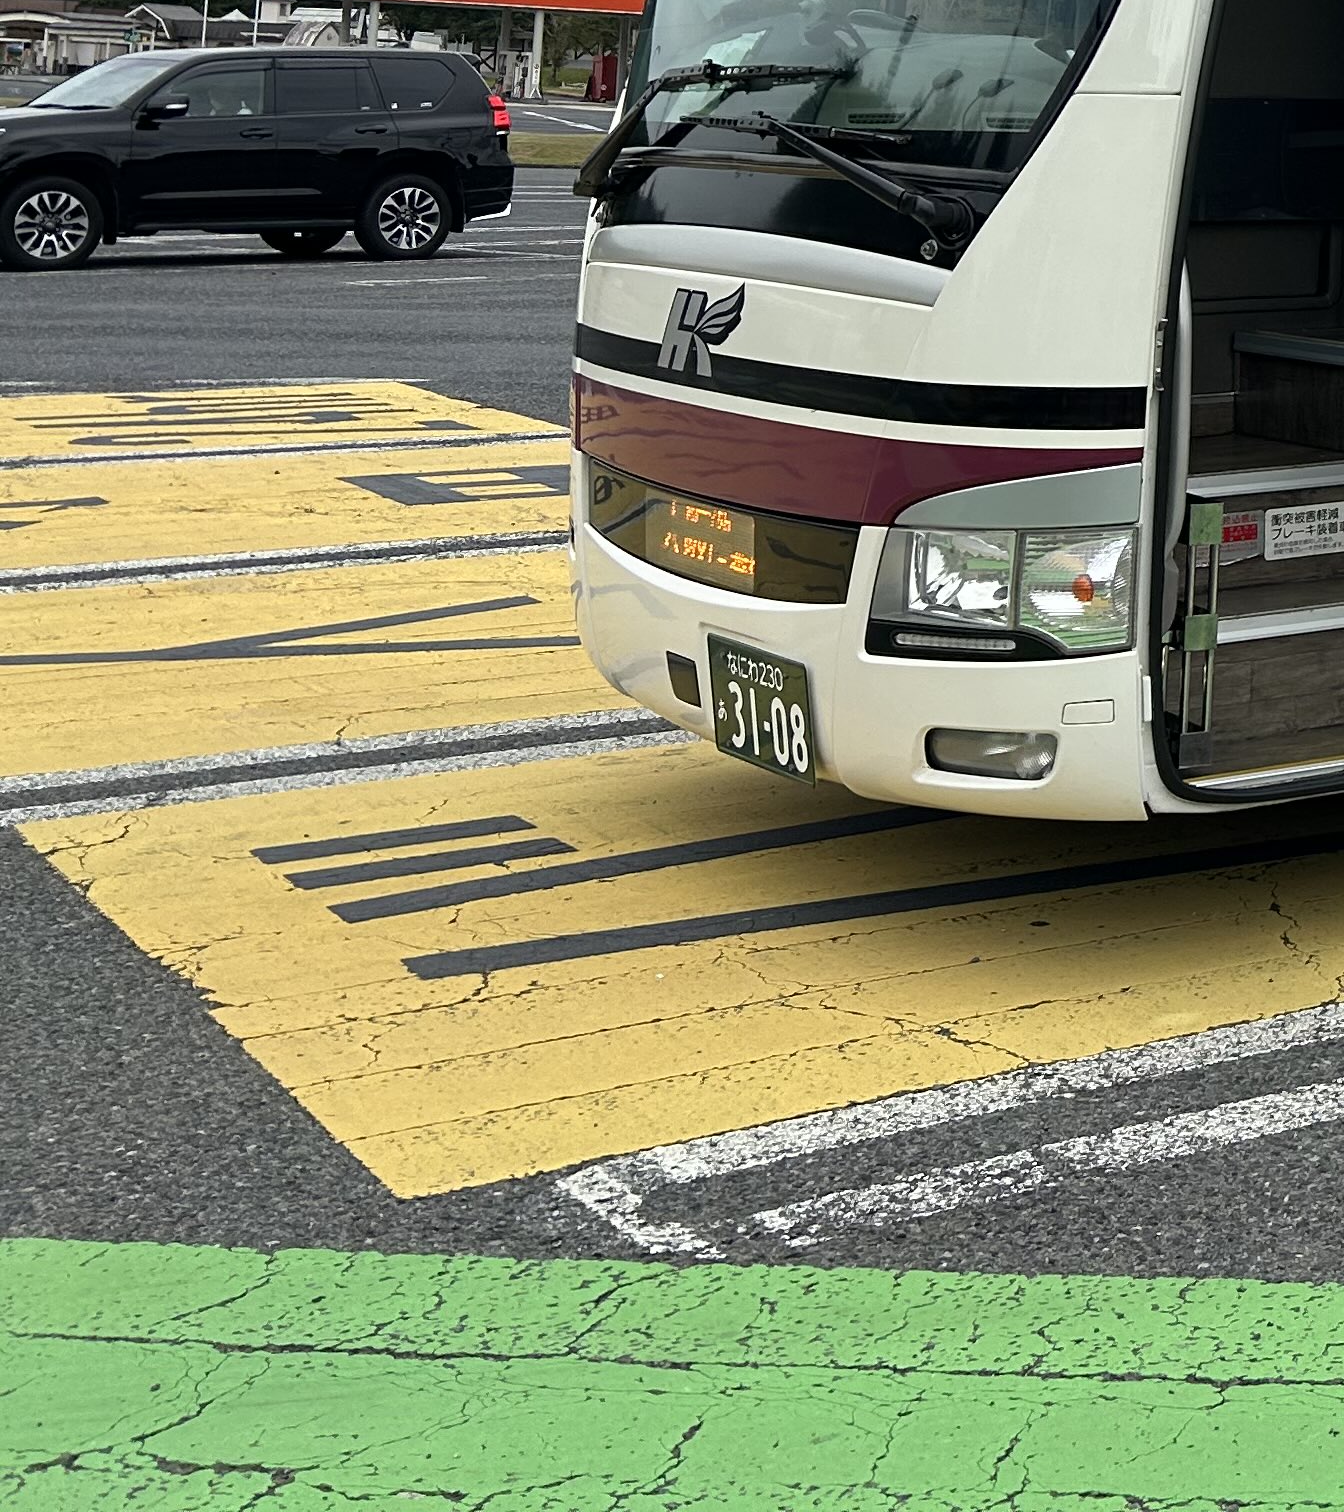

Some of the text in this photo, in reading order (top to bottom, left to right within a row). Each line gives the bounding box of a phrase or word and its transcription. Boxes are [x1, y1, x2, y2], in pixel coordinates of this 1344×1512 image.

[1271, 508, 1339, 527] 衝突被害軽減
[718, 680, 809, 774] あ 31-08
